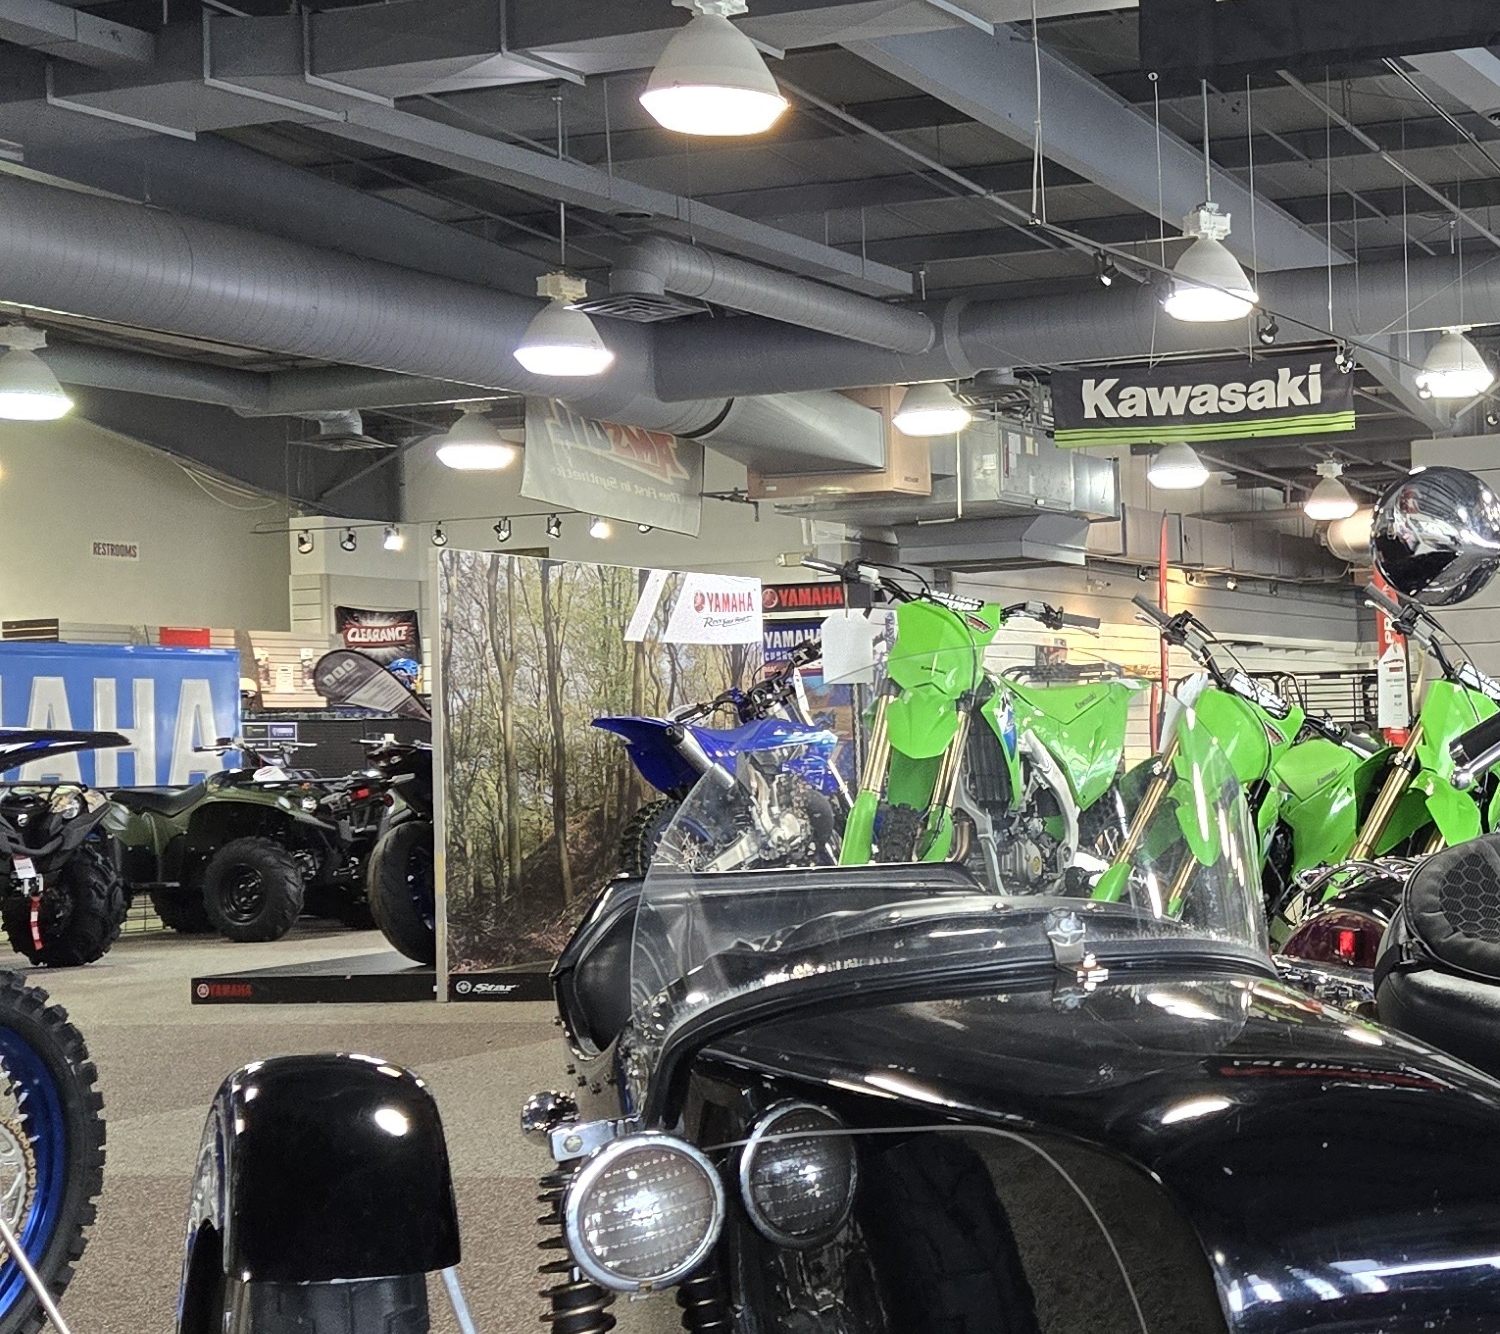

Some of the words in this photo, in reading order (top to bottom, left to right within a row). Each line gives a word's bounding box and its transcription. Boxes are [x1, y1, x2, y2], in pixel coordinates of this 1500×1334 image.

[1082, 363, 1322, 419] Kawasaki
[93, 542, 137, 558] RESTROOMS
[706, 591, 755, 613] YAMAHA
[778, 586, 844, 607] YAMAHA
[347, 625, 409, 643] CLEARANCE
[0, 676, 225, 786] AHA
[472, 983, 519, 994] Star
